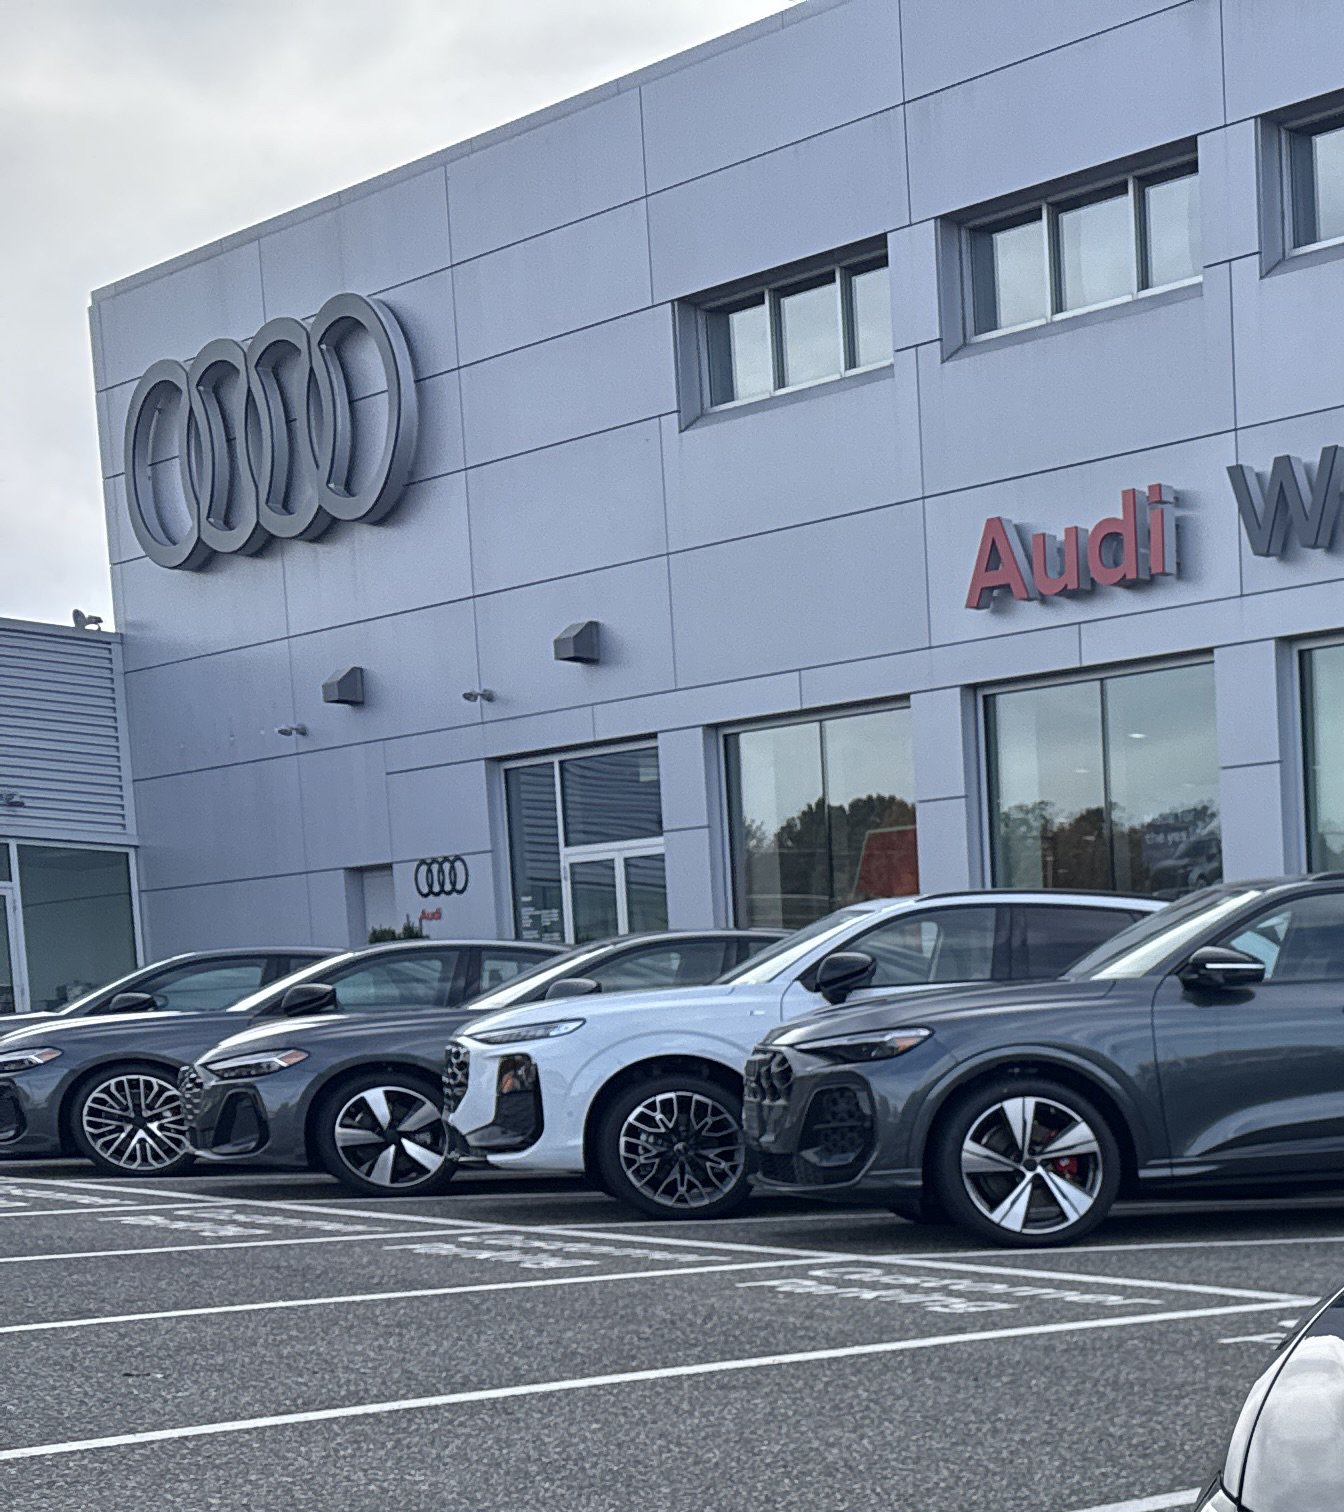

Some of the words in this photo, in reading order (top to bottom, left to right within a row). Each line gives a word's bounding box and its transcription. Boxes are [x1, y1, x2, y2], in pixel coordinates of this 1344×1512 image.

[965, 483, 1175, 610] Audi
[383, 1243, 602, 1268] Parking
[459, 1235, 732, 1262] Customer
[735, 1279, 1018, 1313] Parking
[809, 1268, 1164, 1305] Customer
